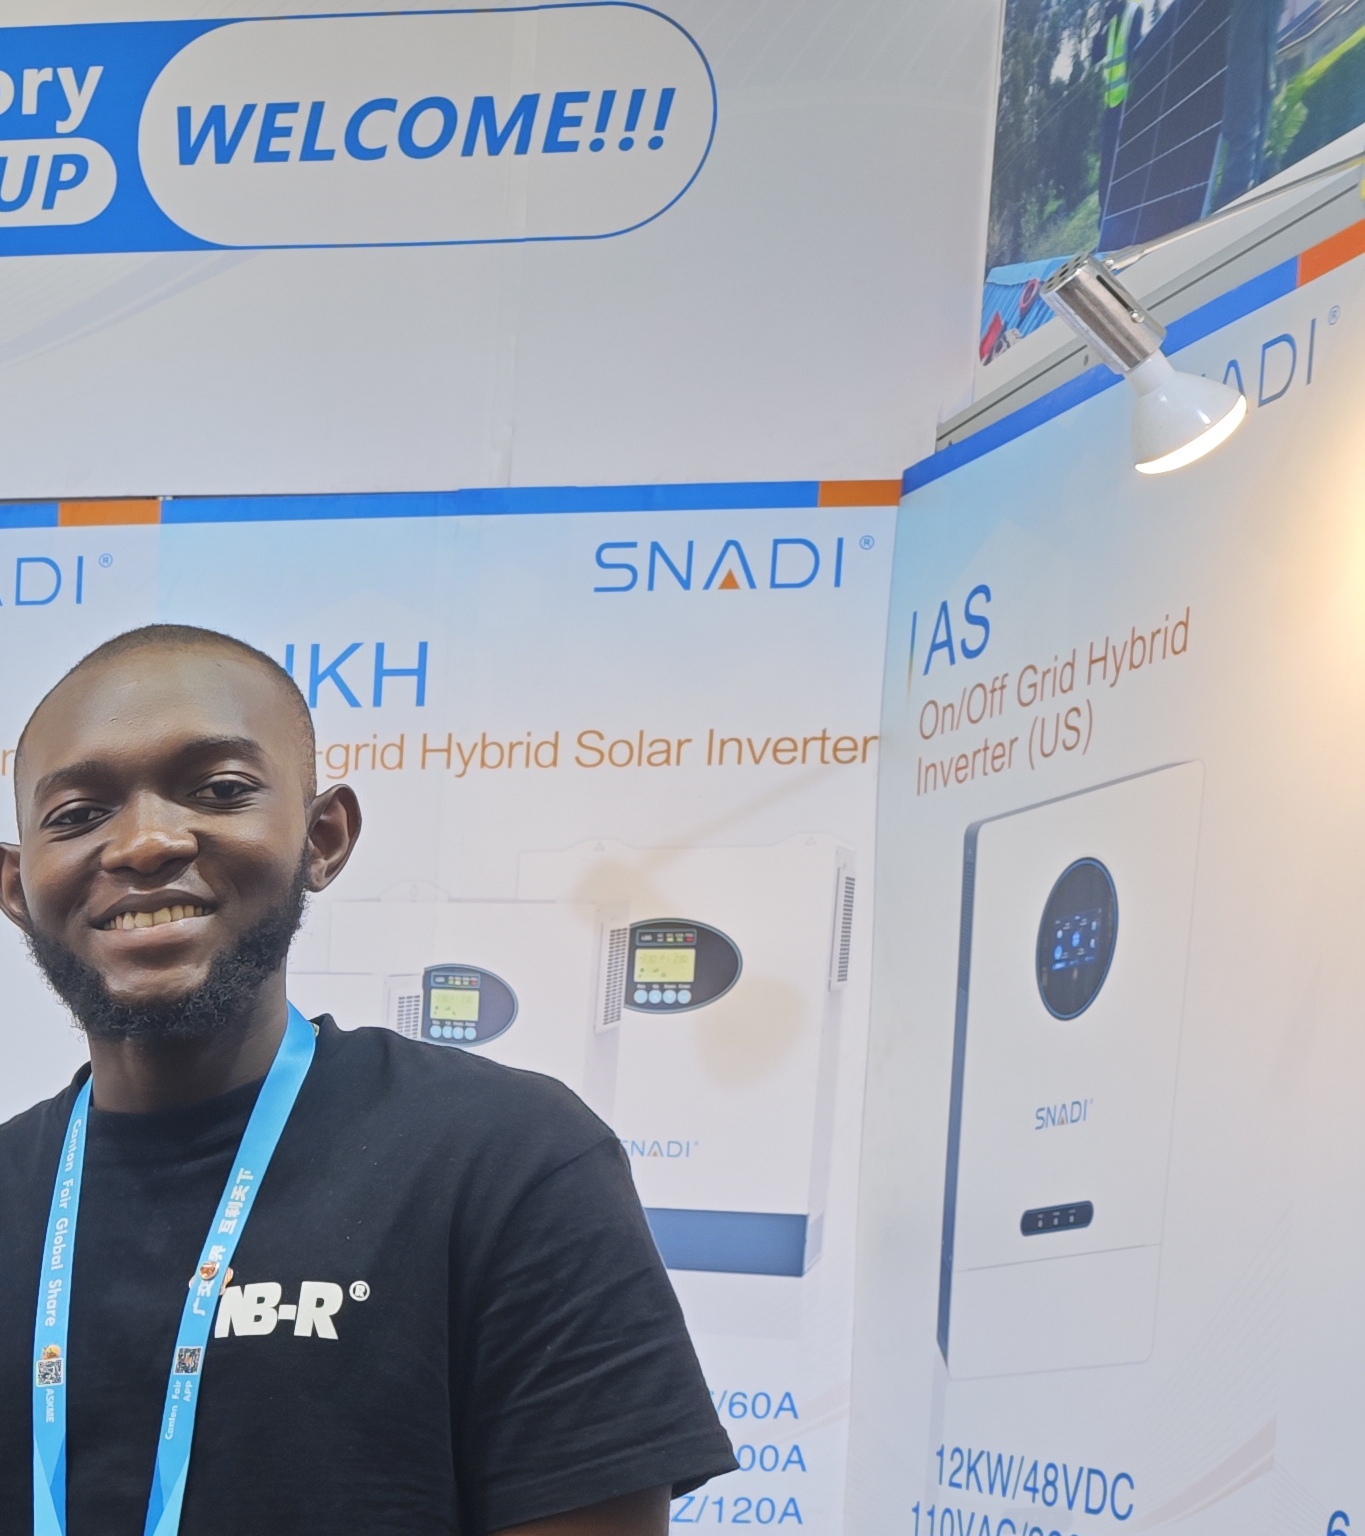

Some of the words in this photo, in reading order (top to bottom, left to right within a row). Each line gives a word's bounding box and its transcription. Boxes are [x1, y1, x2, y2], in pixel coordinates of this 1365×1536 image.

[175, 86, 677, 166] WELCOME!!!
[923, 584, 992, 676] AS
[285, 641, 429, 709] KH
[919, 673, 1009, 741] On/Off
[1017, 647, 1075, 708] Grid
[1087, 606, 1190, 688] Hybrid
[420, 730, 560, 778] Hybrid
[575, 729, 692, 768] Solar
[706, 728, 879, 768] Inverter
[916, 733, 1018, 796] Inverter
[1028, 699, 1093, 770] (US)
[66, 1118, 82, 1172] Canton
[59, 1177, 74, 1211] Fair
[52, 1217, 69, 1271] Global
[45, 1277, 62, 1328] Share
[710, 1390, 799, 1419] /60A
[935, 1444, 1135, 1521] 12KW/48VDC
